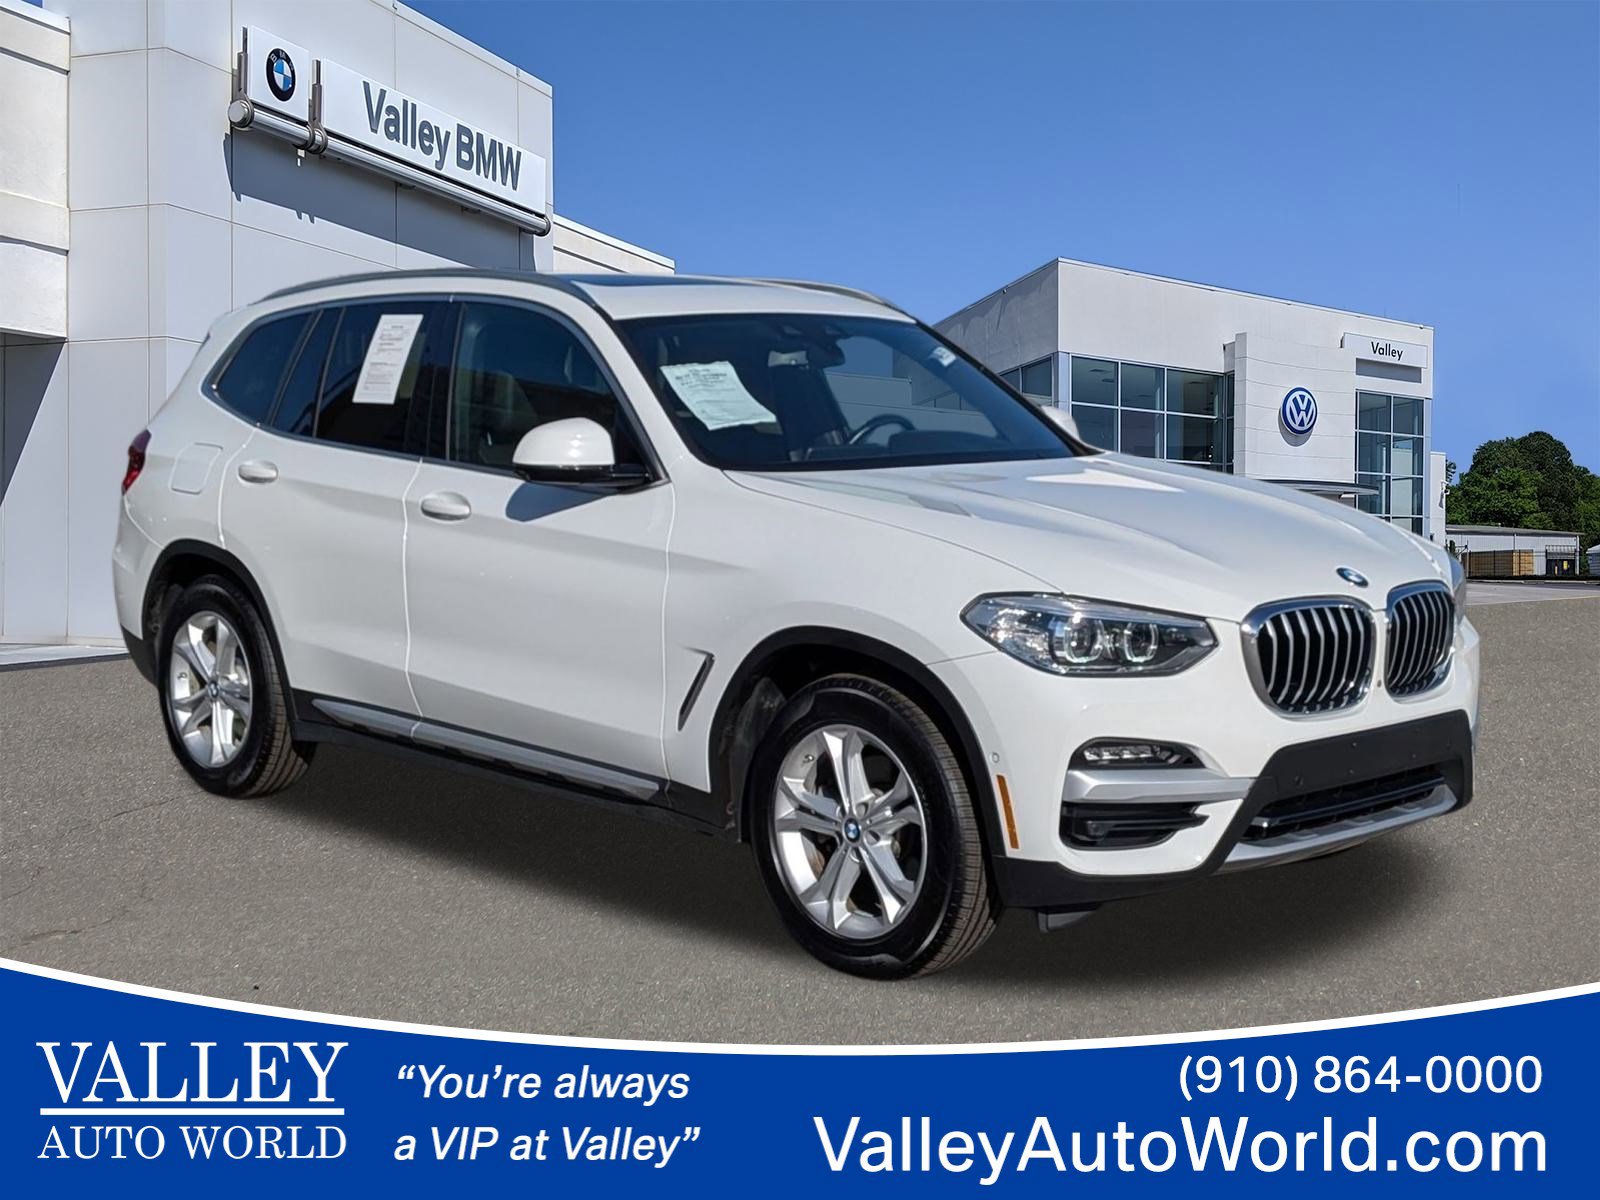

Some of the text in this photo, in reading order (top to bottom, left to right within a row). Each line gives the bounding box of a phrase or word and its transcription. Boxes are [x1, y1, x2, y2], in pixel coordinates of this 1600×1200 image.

[362, 81, 522, 191] Valley BMW
[1371, 341, 1403, 361] Valley
